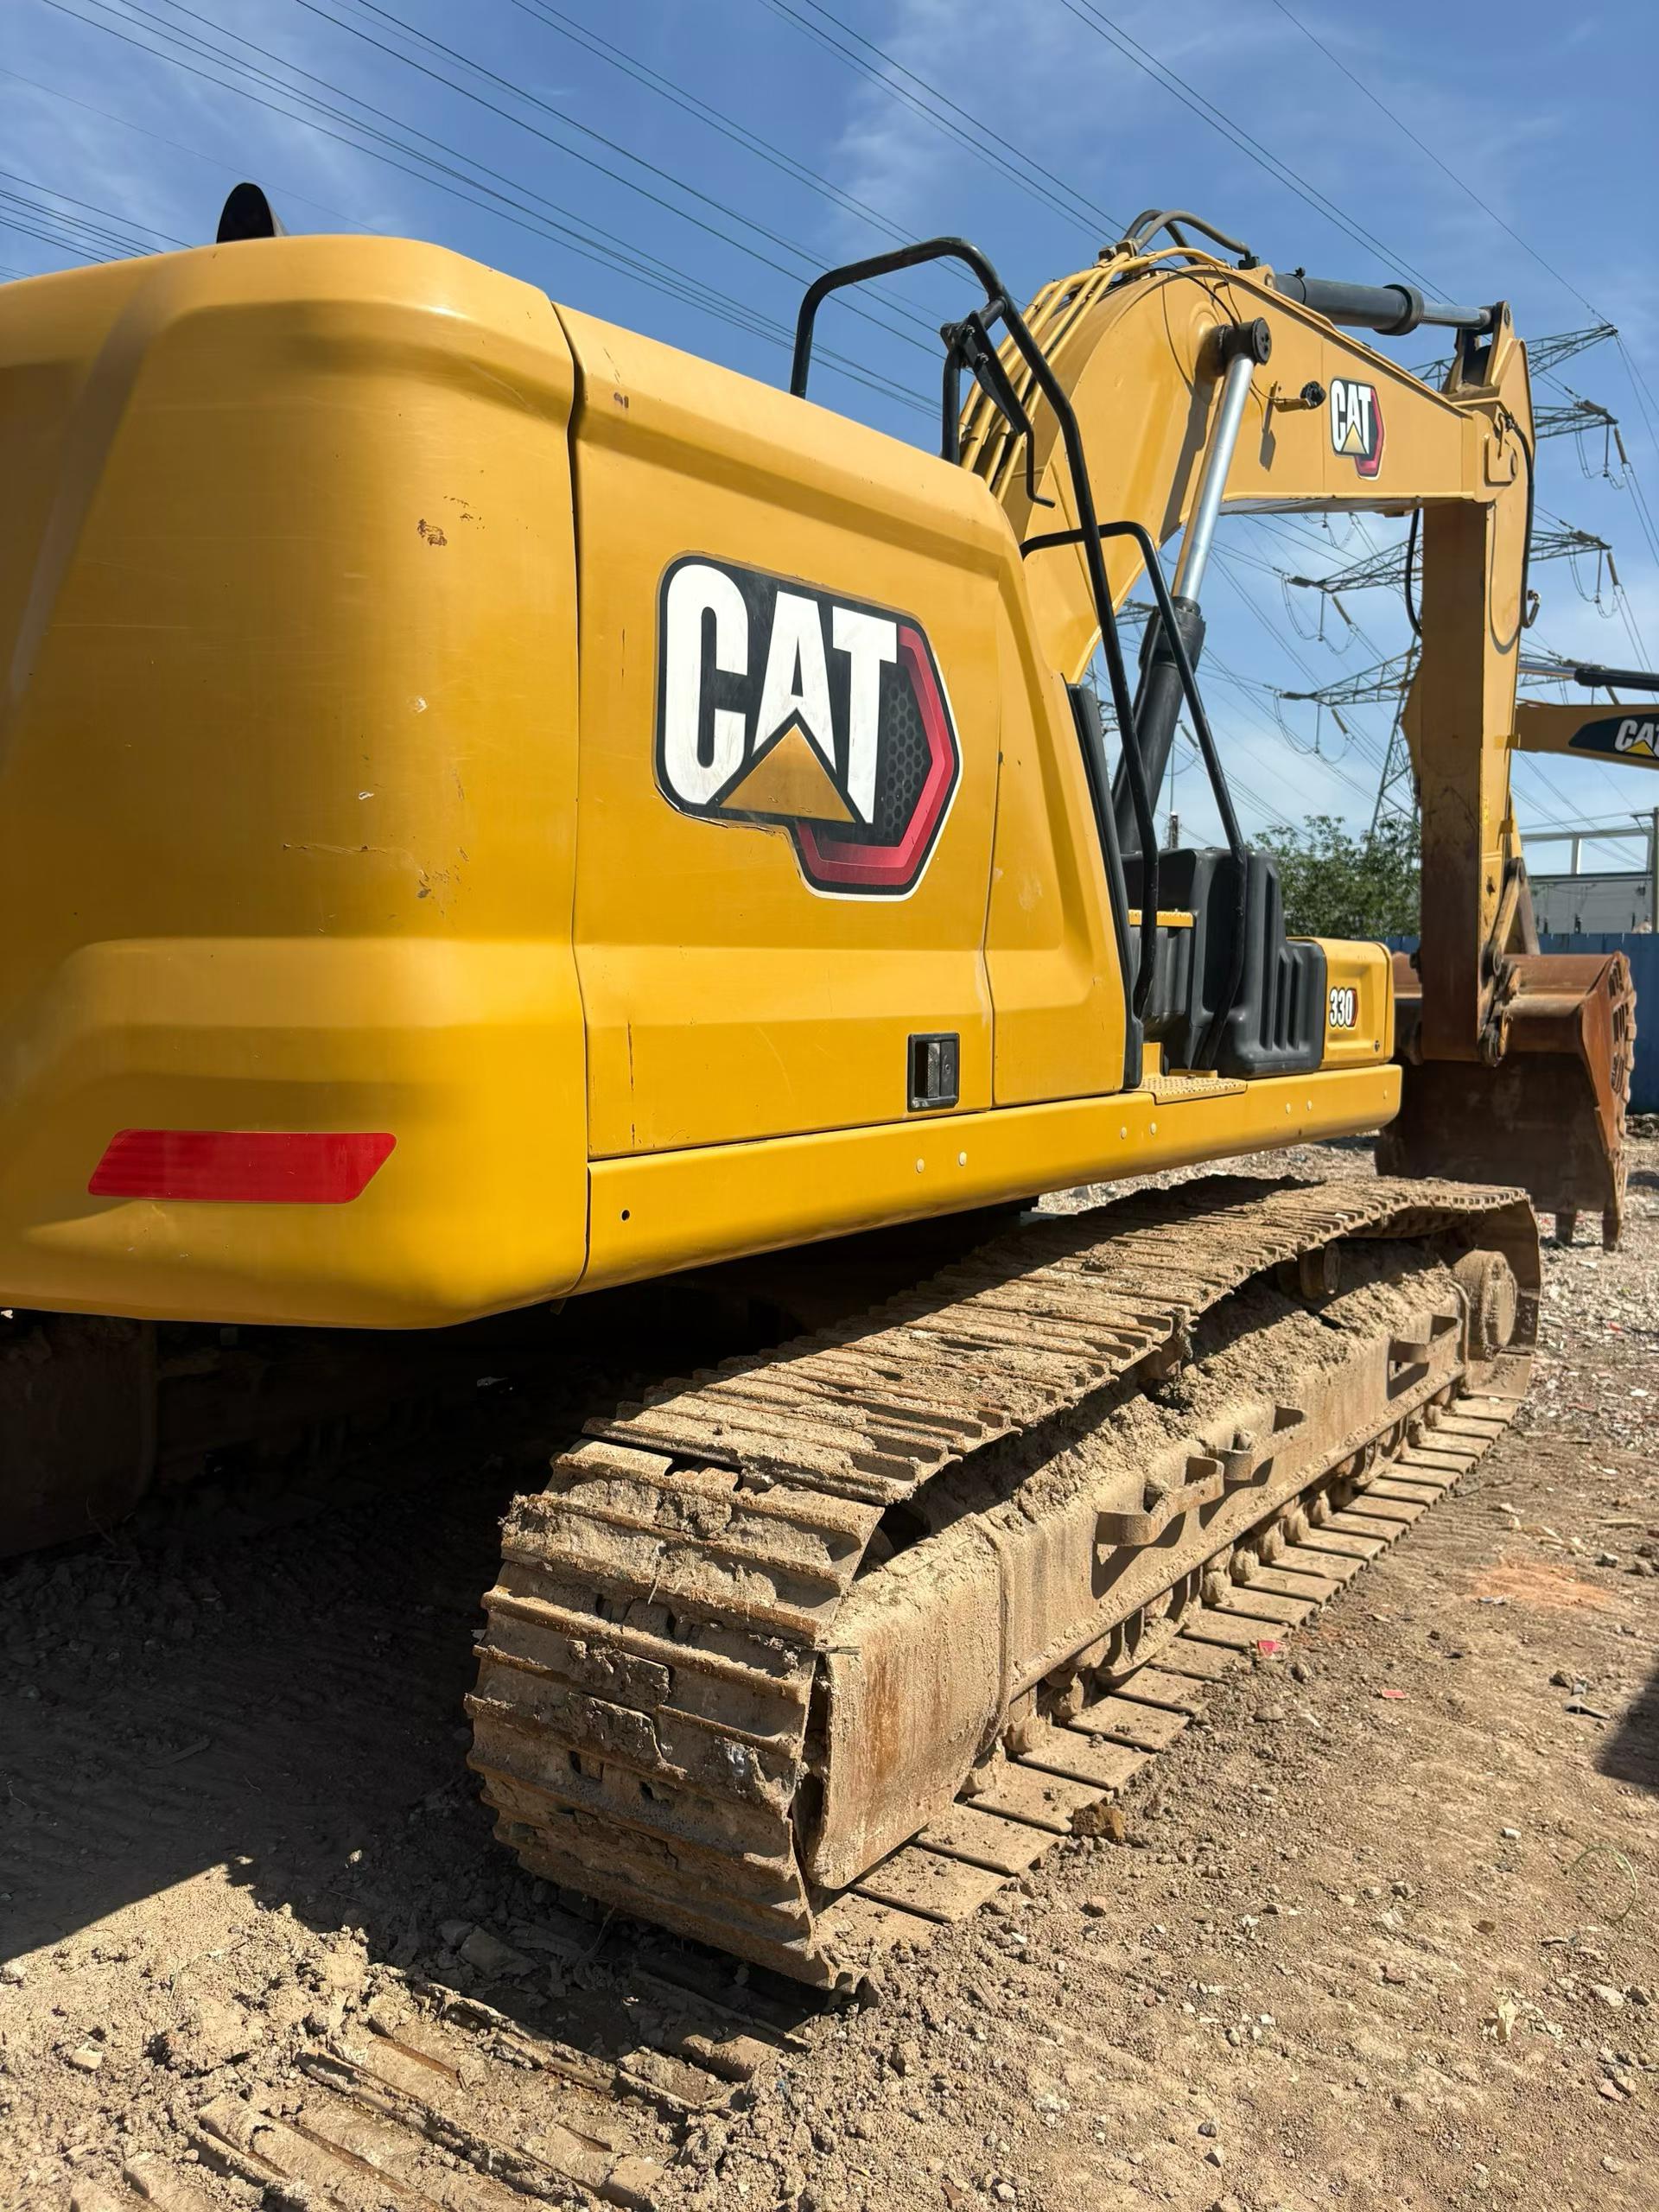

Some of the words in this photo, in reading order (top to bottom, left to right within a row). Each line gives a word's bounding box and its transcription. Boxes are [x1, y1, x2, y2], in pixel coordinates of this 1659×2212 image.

[1331, 379, 1371, 454] CAT
[664, 564, 897, 824] CAT
[1330, 988, 1353, 1027] 330
